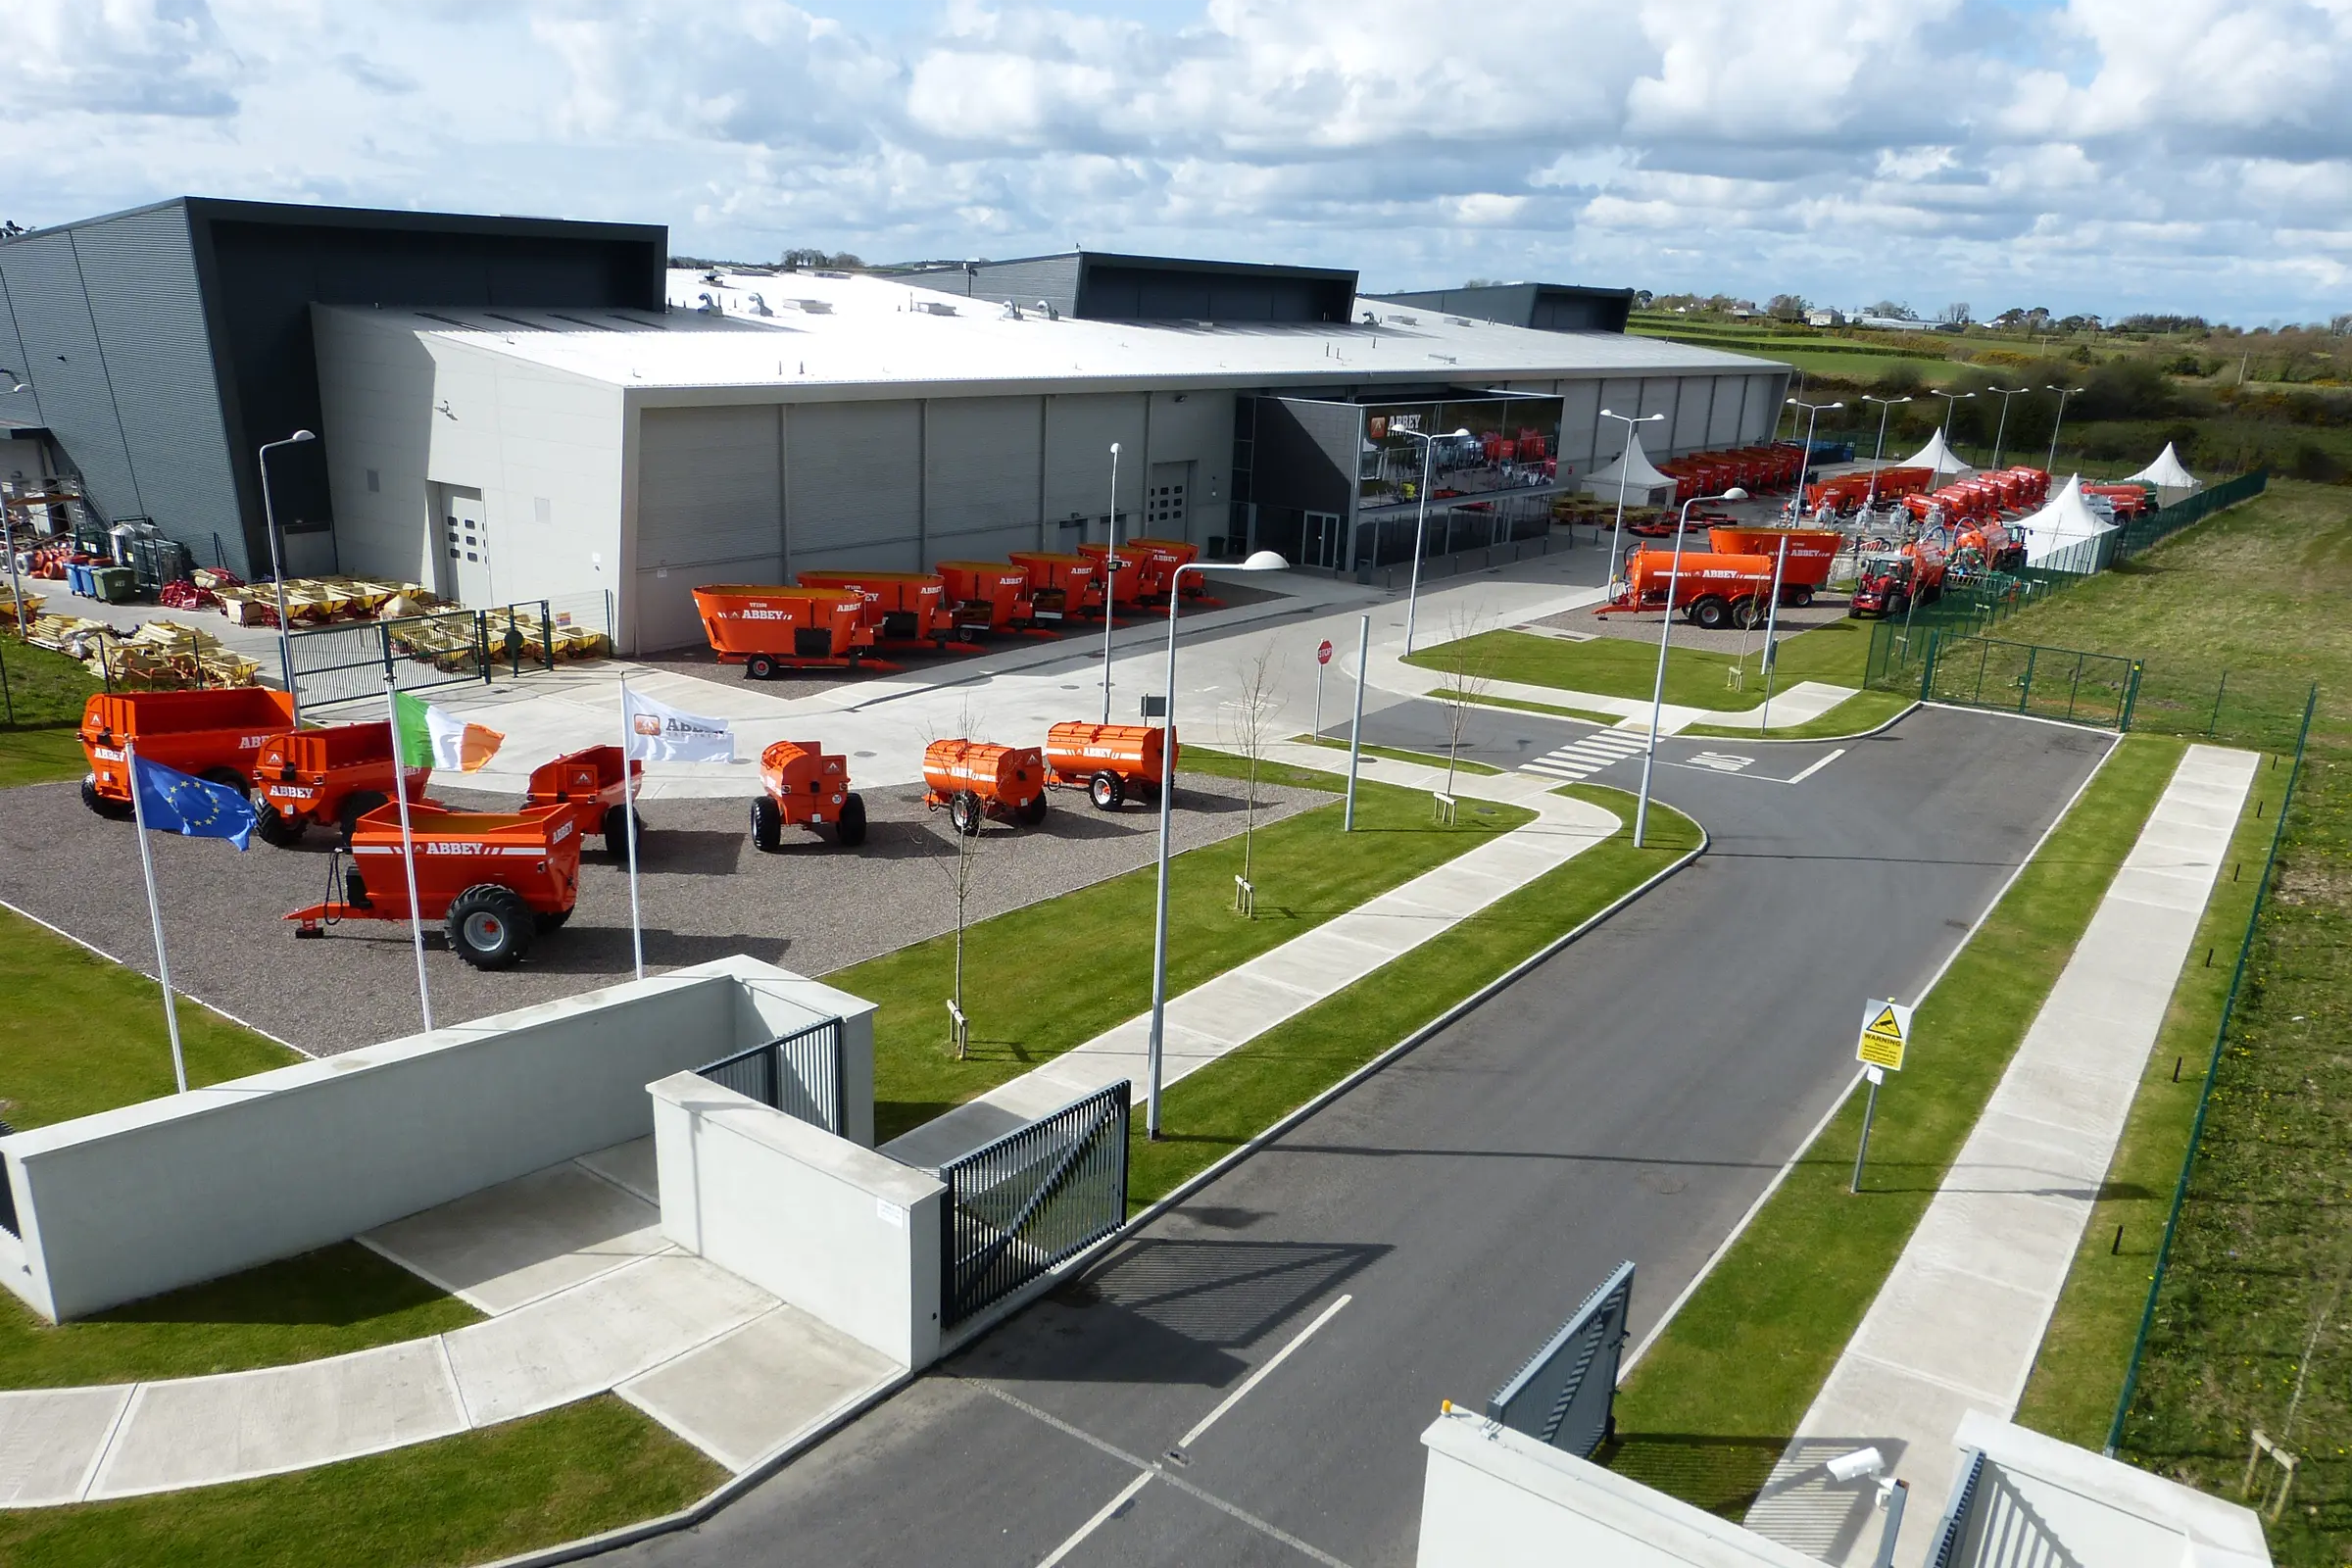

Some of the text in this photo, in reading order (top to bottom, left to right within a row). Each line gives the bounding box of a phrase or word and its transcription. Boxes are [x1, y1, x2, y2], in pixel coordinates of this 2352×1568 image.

[1388, 415, 1421, 430] ABBEY
[1152, 554, 1178, 564] ABBEY
[1790, 549, 1820, 558] ABBEY
[1702, 569, 1740, 579] ABBEY
[836, 603, 862, 612] ABBEY
[741, 610, 785, 620] ABBEY
[94, 748, 125, 762] ABBEY
[1082, 747, 1112, 759] ABBEY
[270, 786, 314, 799] ABBEY
[553, 819, 573, 845] ABBEY
[426, 842, 484, 855] ABBEY
[1864, 1033, 1901, 1047] WARNING
